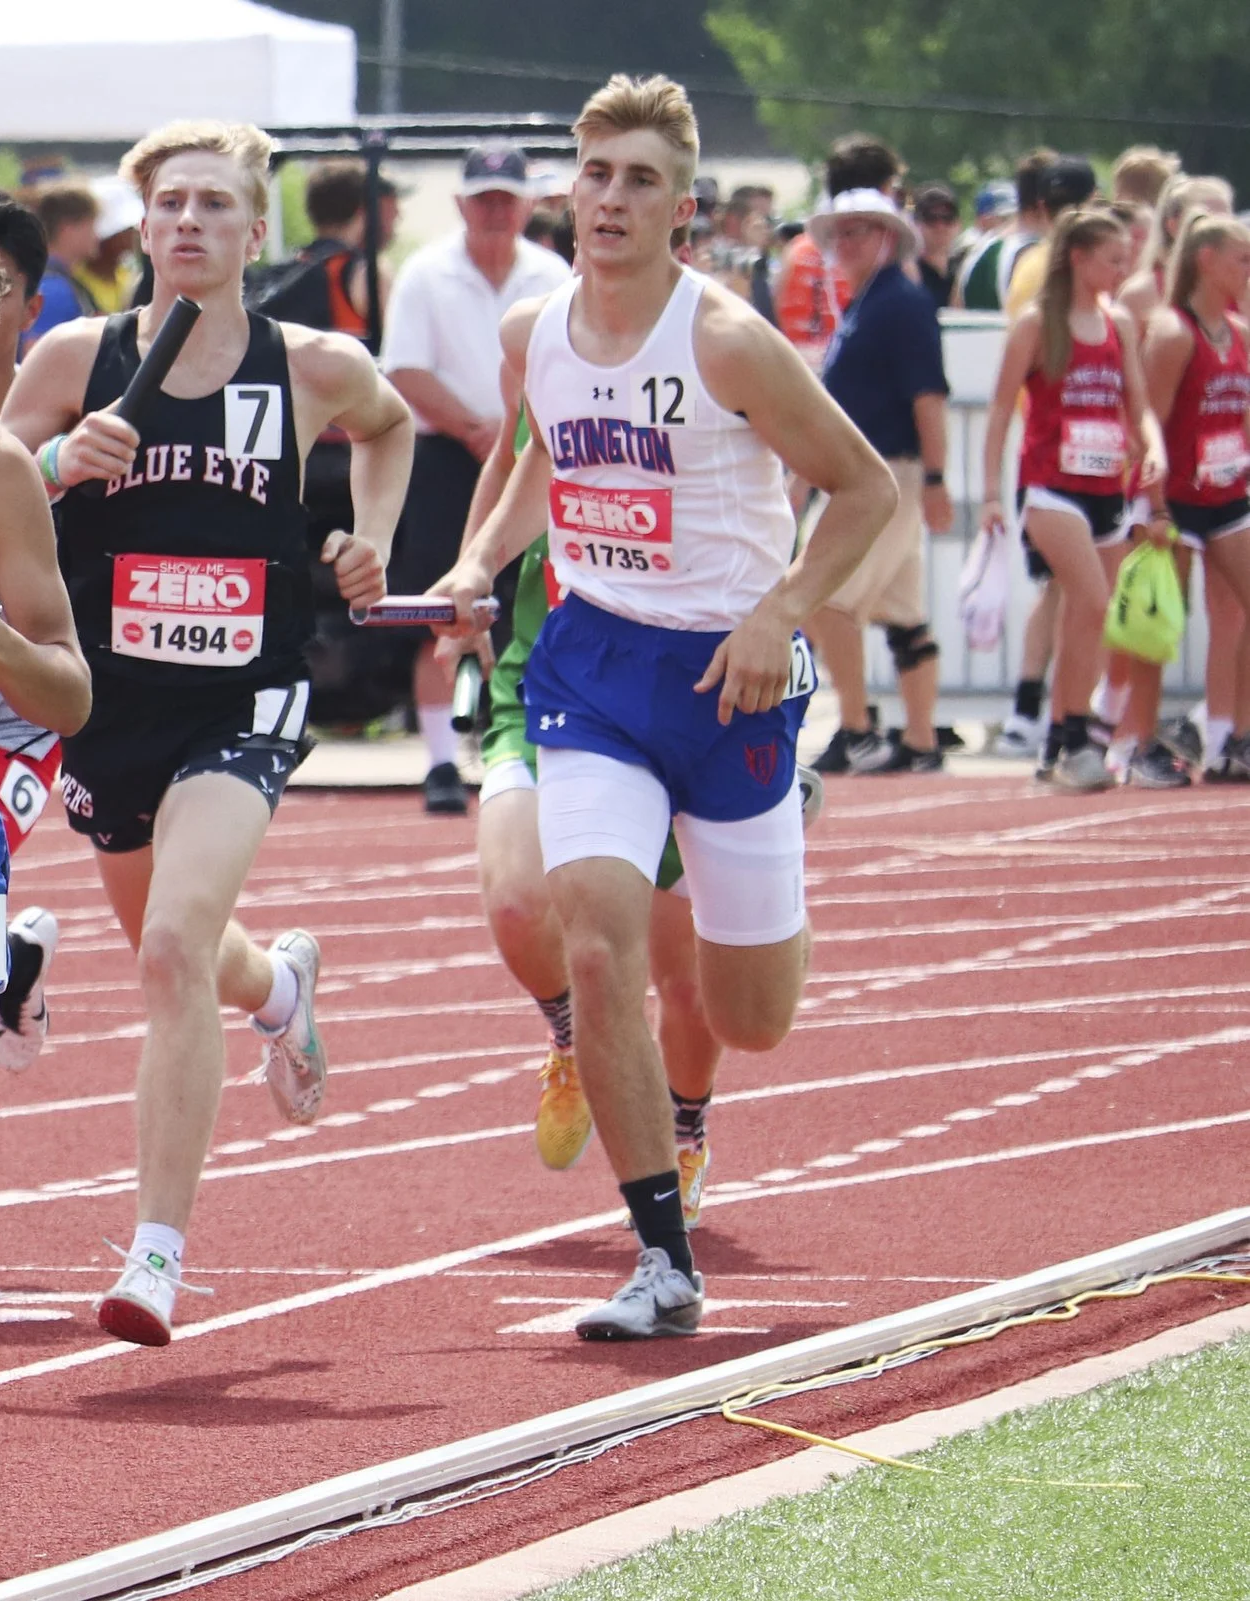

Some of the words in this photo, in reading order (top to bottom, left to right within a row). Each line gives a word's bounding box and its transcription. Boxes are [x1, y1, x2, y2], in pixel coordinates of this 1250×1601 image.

[642, 377, 685, 425] 12
[238, 390, 269, 455] 7
[549, 418, 676, 476] LEXINGTON
[203, 446, 270, 505] EYE
[560, 493, 657, 535] ZERO
[578, 490, 631, 505] SHOW-ME
[160, 563, 225, 576] SHOW-ME
[585, 543, 649, 571] 1735
[129, 570, 250, 608] ZERO
[150, 623, 227, 654] 1494
[12, 774, 39, 816] 6
